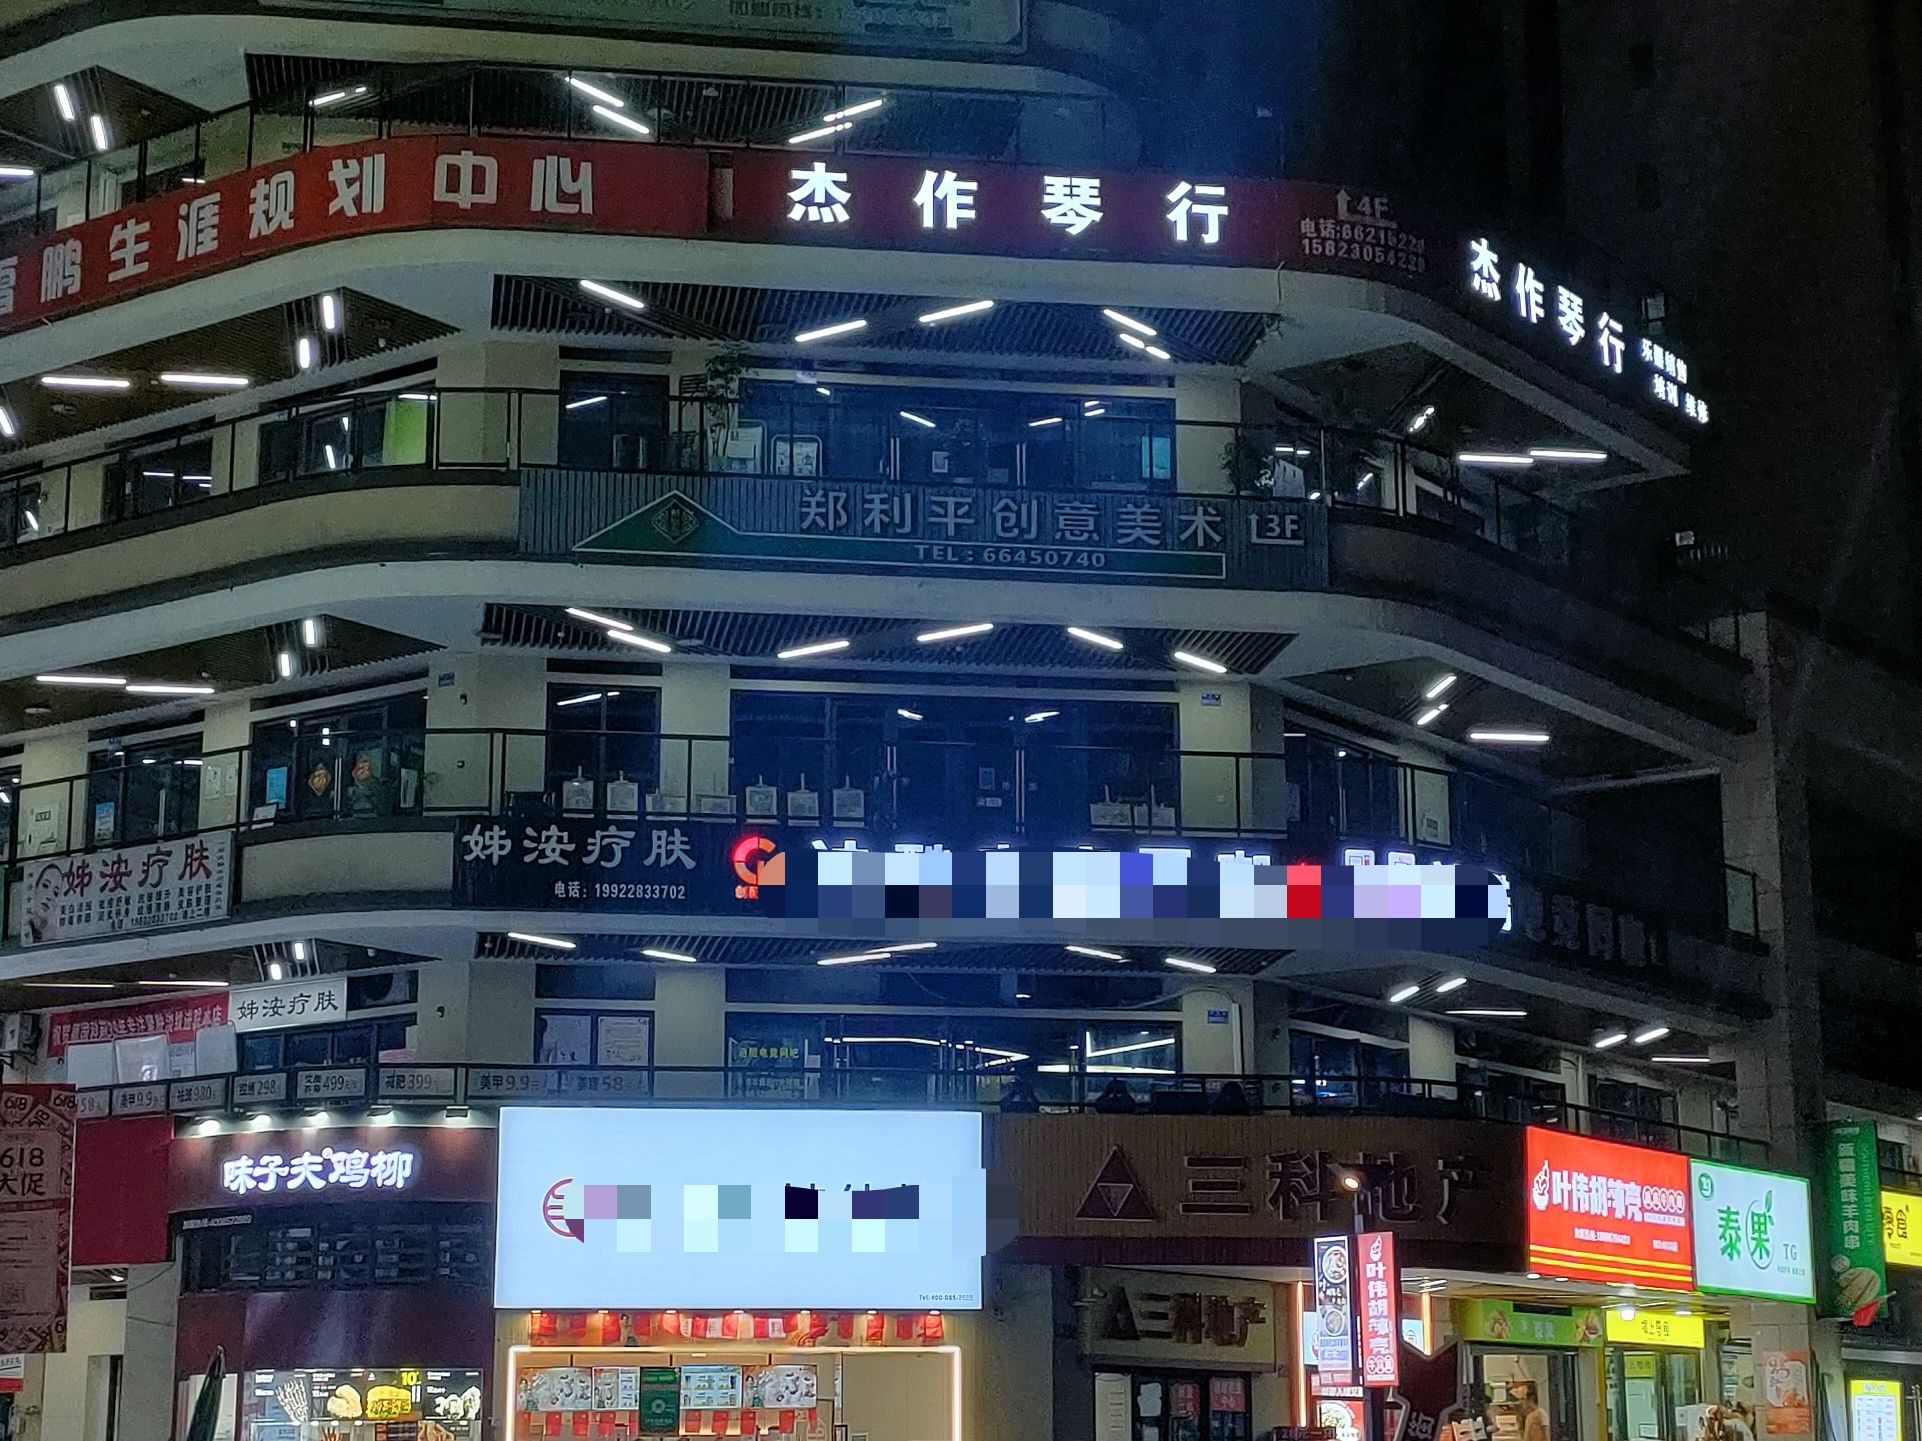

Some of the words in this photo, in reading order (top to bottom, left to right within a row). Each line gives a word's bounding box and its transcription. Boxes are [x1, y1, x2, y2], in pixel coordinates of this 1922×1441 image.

[787, 161, 1230, 245] 杰作琴行
[1356, 195, 1391, 220] 4F
[1468, 237, 1626, 376] 杰作琴行
[799, 487, 1224, 548] 郑利平创意美术
[1263, 511, 1300, 540] 3F
[981, 547, 1107, 570] 66450740
[0, 1147, 44, 1169] 618
[0, 1173, 46, 1197] 大促
[1717, 1204, 1771, 1262] 泰果
[1782, 1243, 1798, 1261] TG
